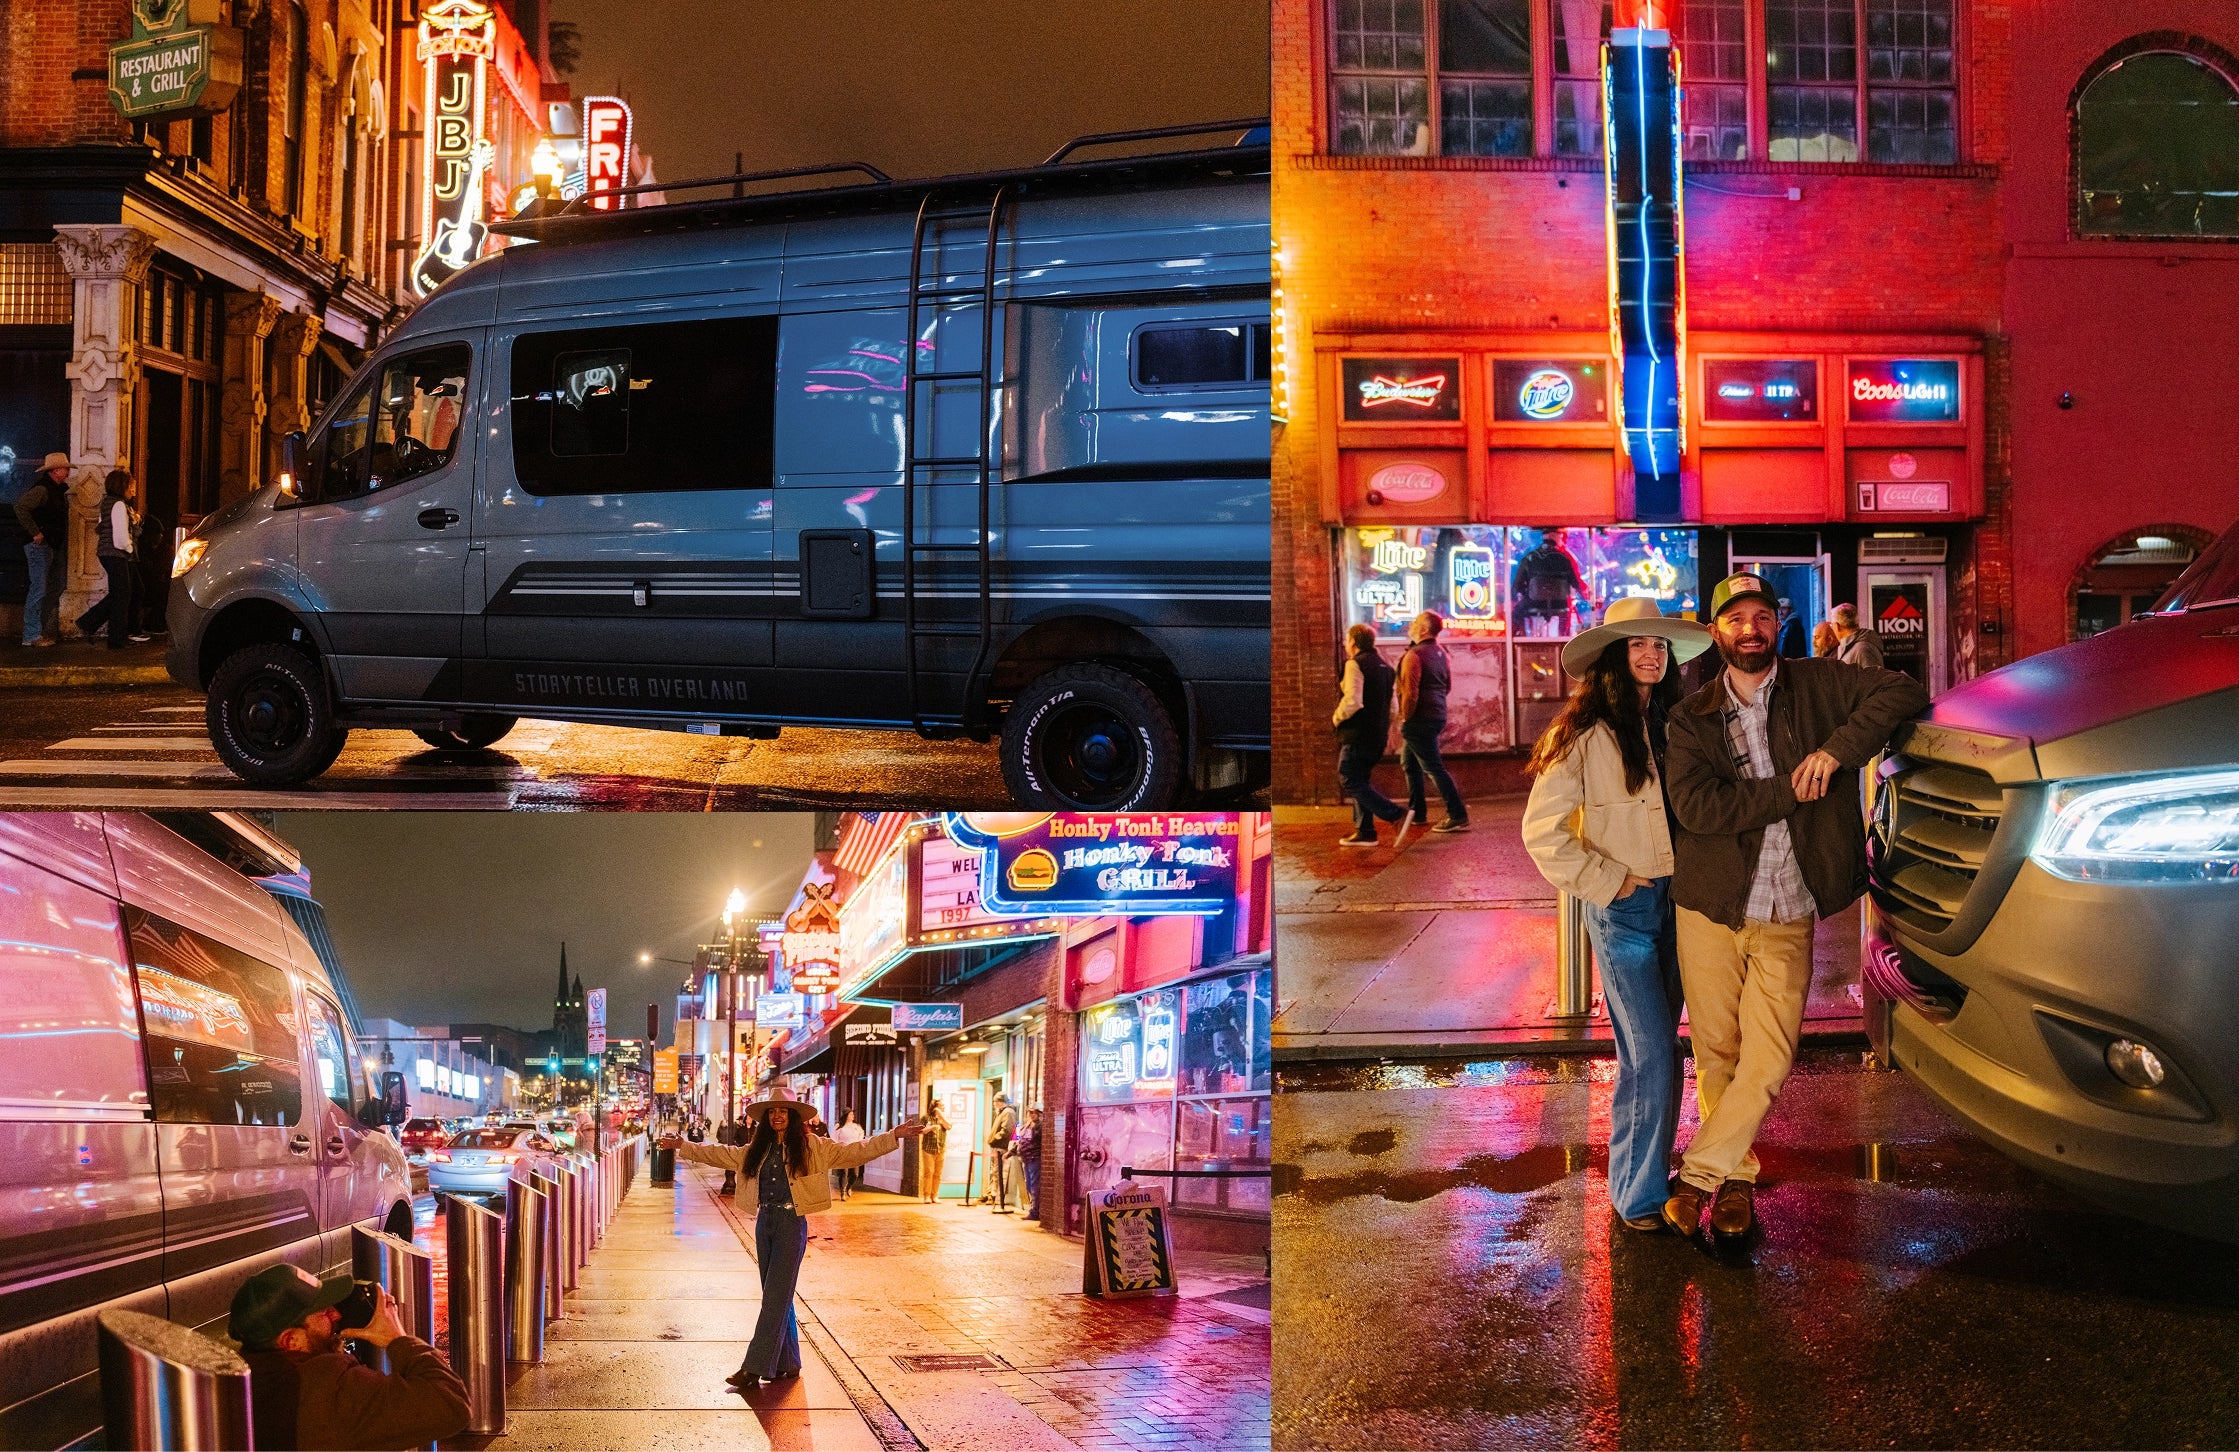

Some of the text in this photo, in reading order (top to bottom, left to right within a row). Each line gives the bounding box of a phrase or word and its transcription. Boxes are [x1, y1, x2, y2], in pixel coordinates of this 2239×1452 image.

[120, 45, 200, 79] RESTAURANT
[131, 70, 187, 98] & GRILL
[1853, 378, 1947, 400] Coors LIGHT
[1370, 540, 1426, 574] Lite
[1455, 558, 1491, 582] Lite
[1356, 591, 1406, 605] ULTRA
[1878, 617, 1924, 634] IKON
[515, 673, 748, 700] STORYTELLER OVERLAND
[1022, 690, 1075, 793] All-Terrain T/A
[1114, 726, 1154, 812] BFGoodric
[1050, 817, 1240, 842] Honky Tonk Heaven
[952, 858, 981, 873] WEL
[1063, 840, 1231, 870] Honky Tonk
[1096, 868, 1195, 891] GRILL
[941, 907, 971, 923] 1997
[1100, 1016, 1132, 1044] Lite
[1092, 1060, 1123, 1072] ULTRA
[1103, 1192, 1152, 1209] Corona
